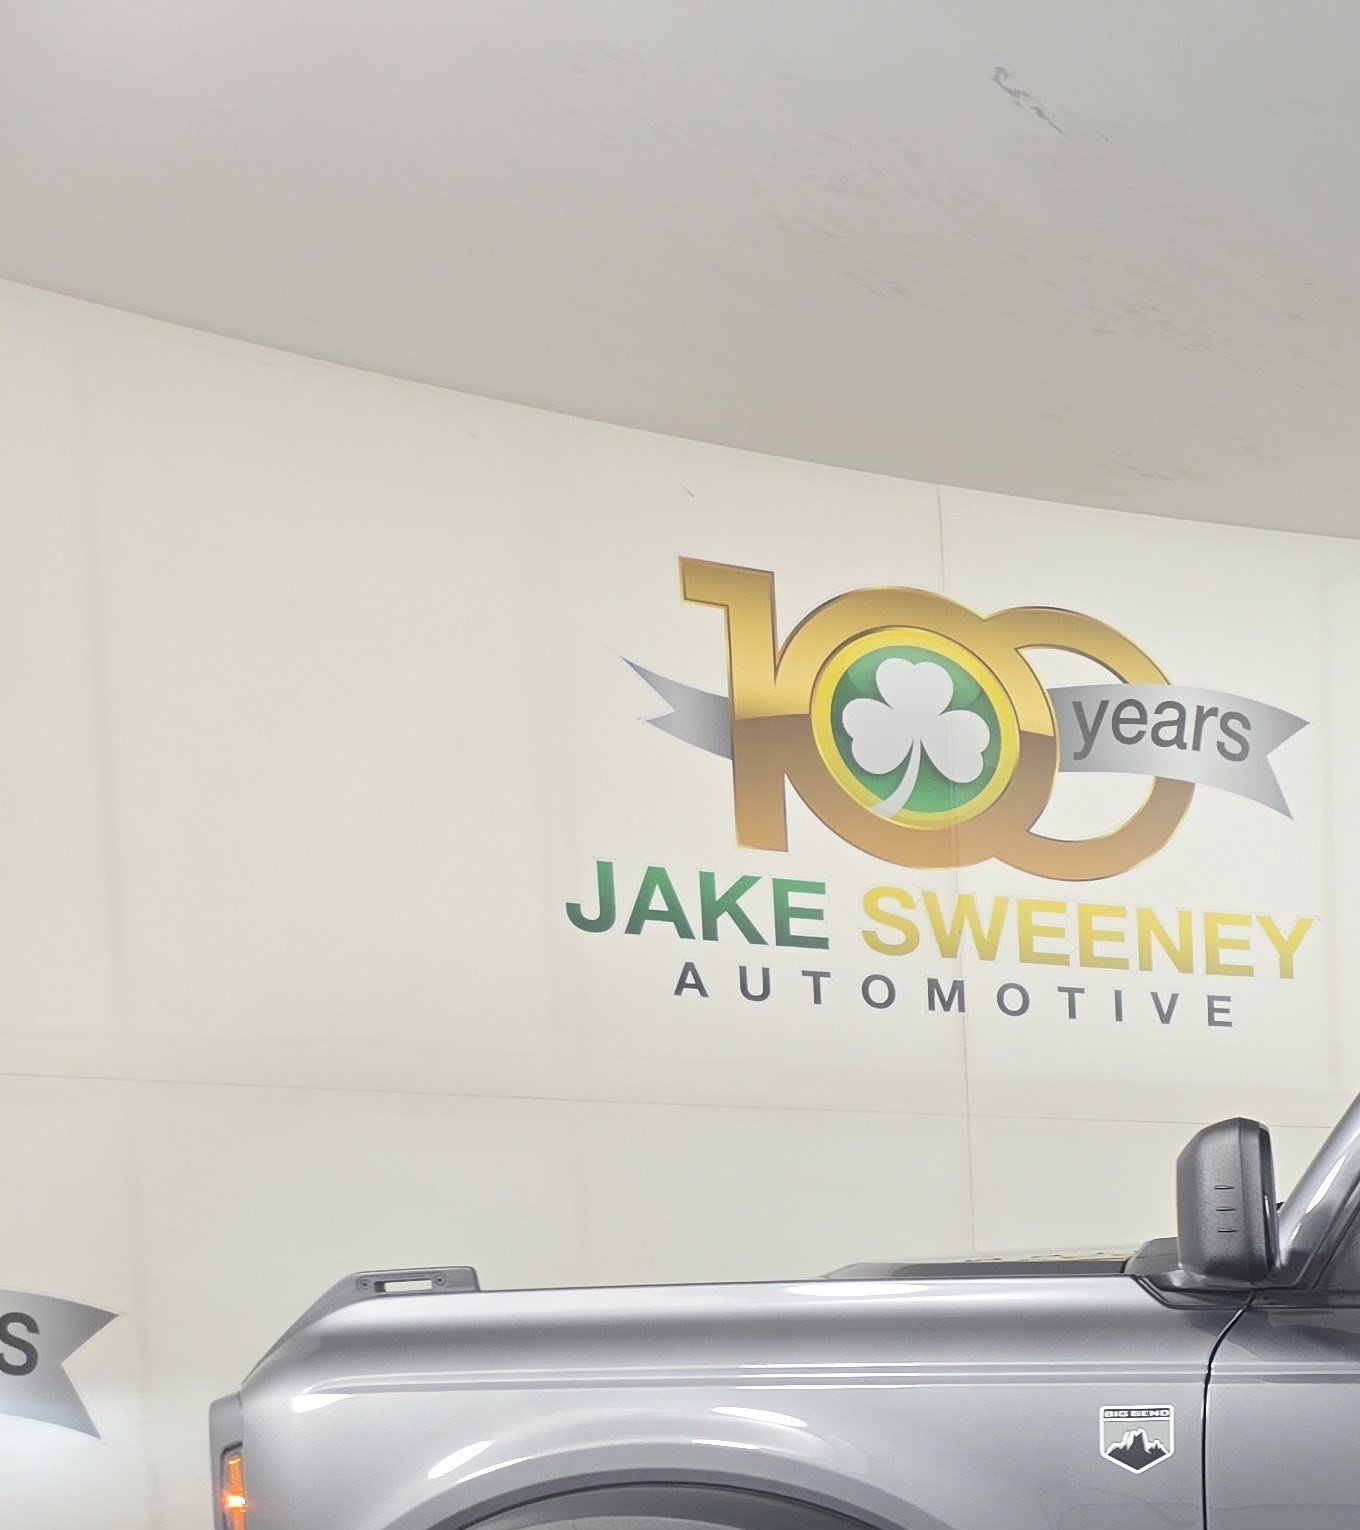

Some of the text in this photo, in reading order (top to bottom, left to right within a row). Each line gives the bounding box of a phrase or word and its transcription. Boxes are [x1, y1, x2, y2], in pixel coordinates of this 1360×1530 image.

[679, 556, 1196, 881] 100
[1073, 698, 1252, 762] years
[565, 858, 1316, 980] JAKE SWEENEY
[673, 961, 1233, 1028] AUTOMOTIVE
